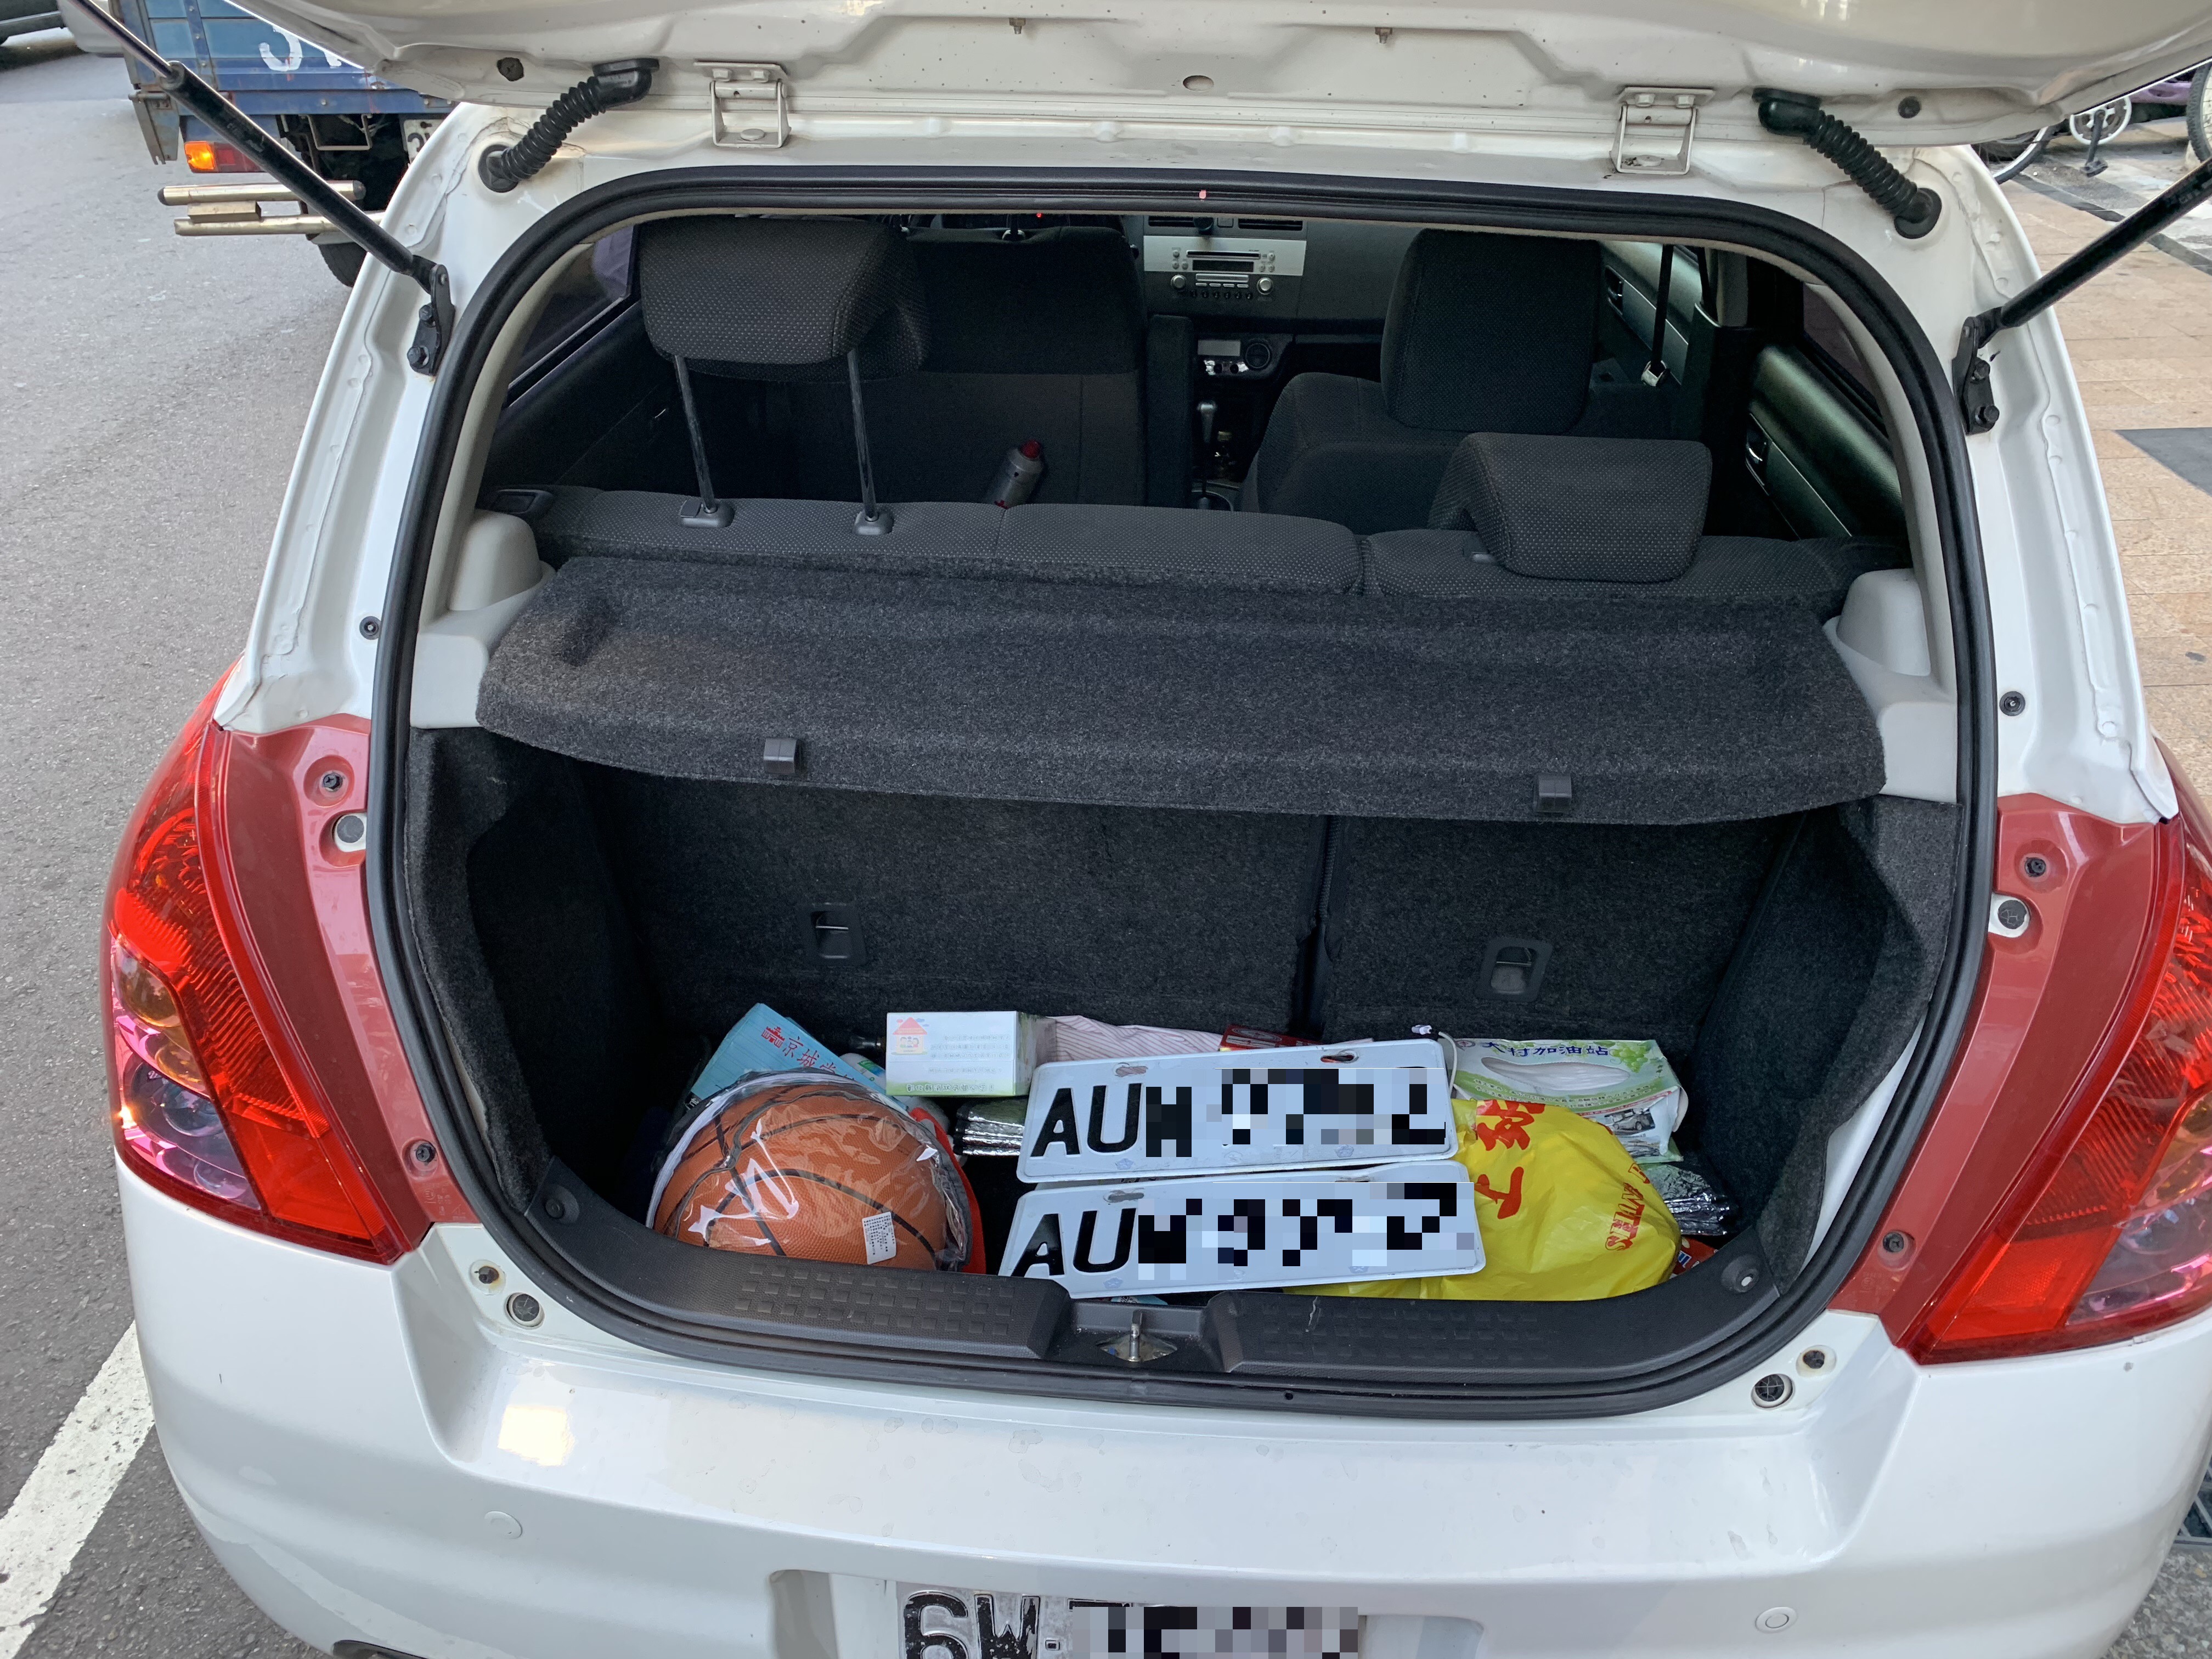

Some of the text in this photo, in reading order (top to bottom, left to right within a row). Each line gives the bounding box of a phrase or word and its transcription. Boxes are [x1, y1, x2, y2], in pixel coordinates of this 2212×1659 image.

[1482, 1042, 1609, 1057] 大村加油站
